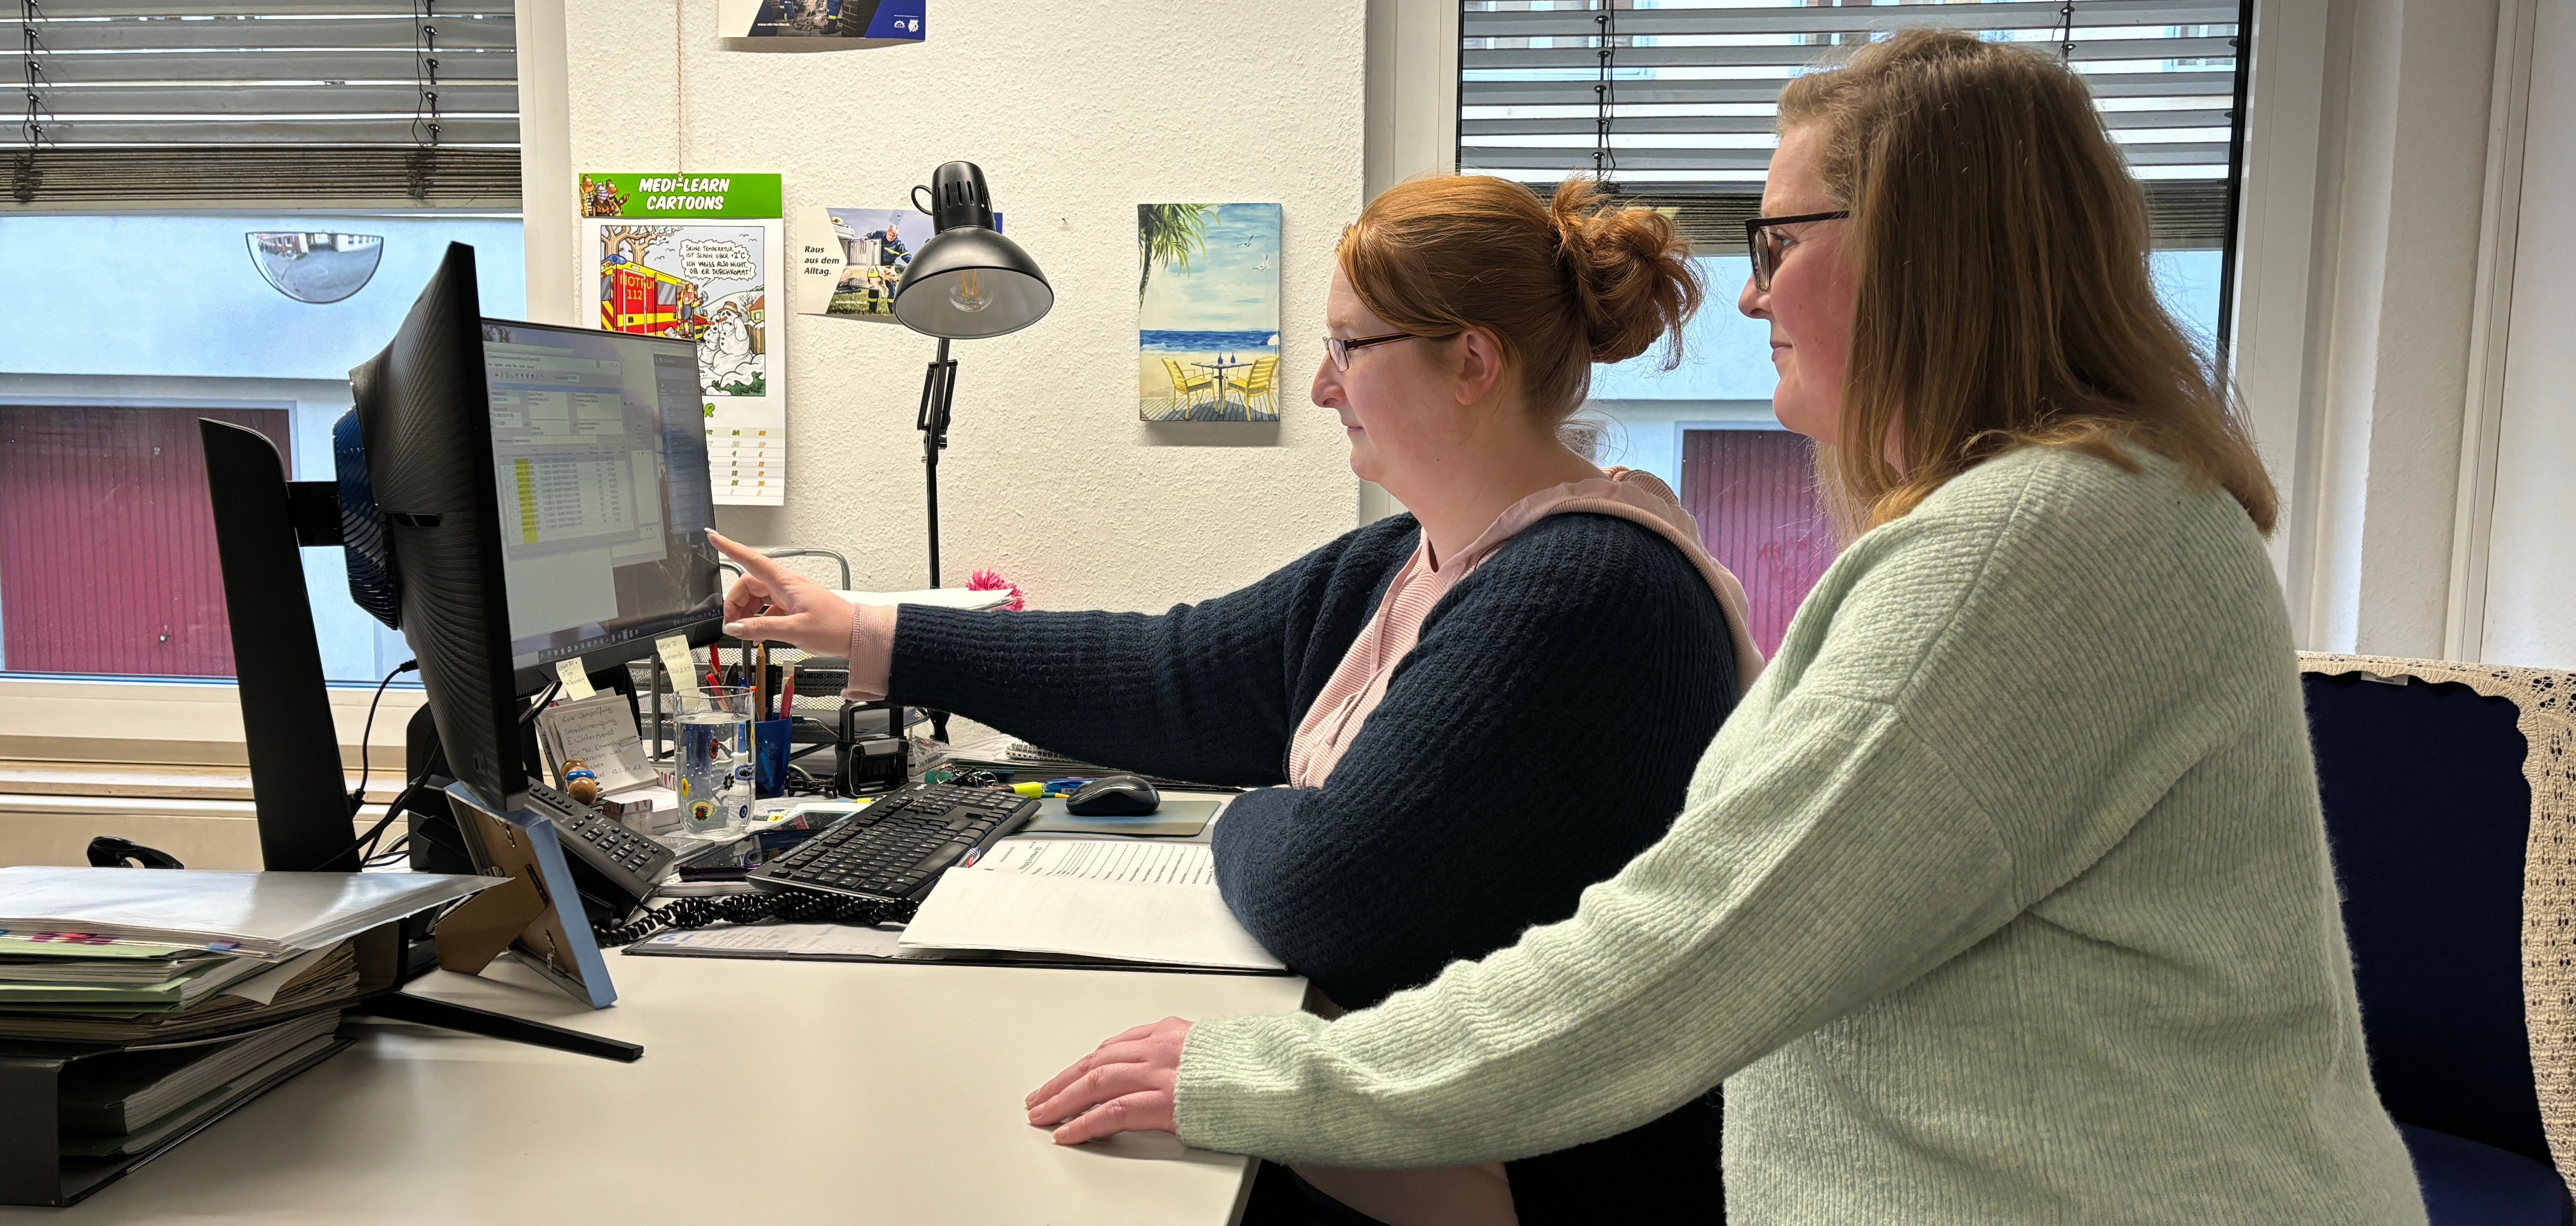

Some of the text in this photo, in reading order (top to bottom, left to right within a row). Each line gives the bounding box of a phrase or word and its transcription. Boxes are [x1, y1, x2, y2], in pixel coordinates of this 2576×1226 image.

[639, 178, 731, 193] MEDI-LEARN
[646, 195, 724, 210] CARTOONS
[713, 266, 751, 276] DURCHKOMMT!
[804, 267, 831, 276] Alltag.
[627, 289, 643, 300] 112
